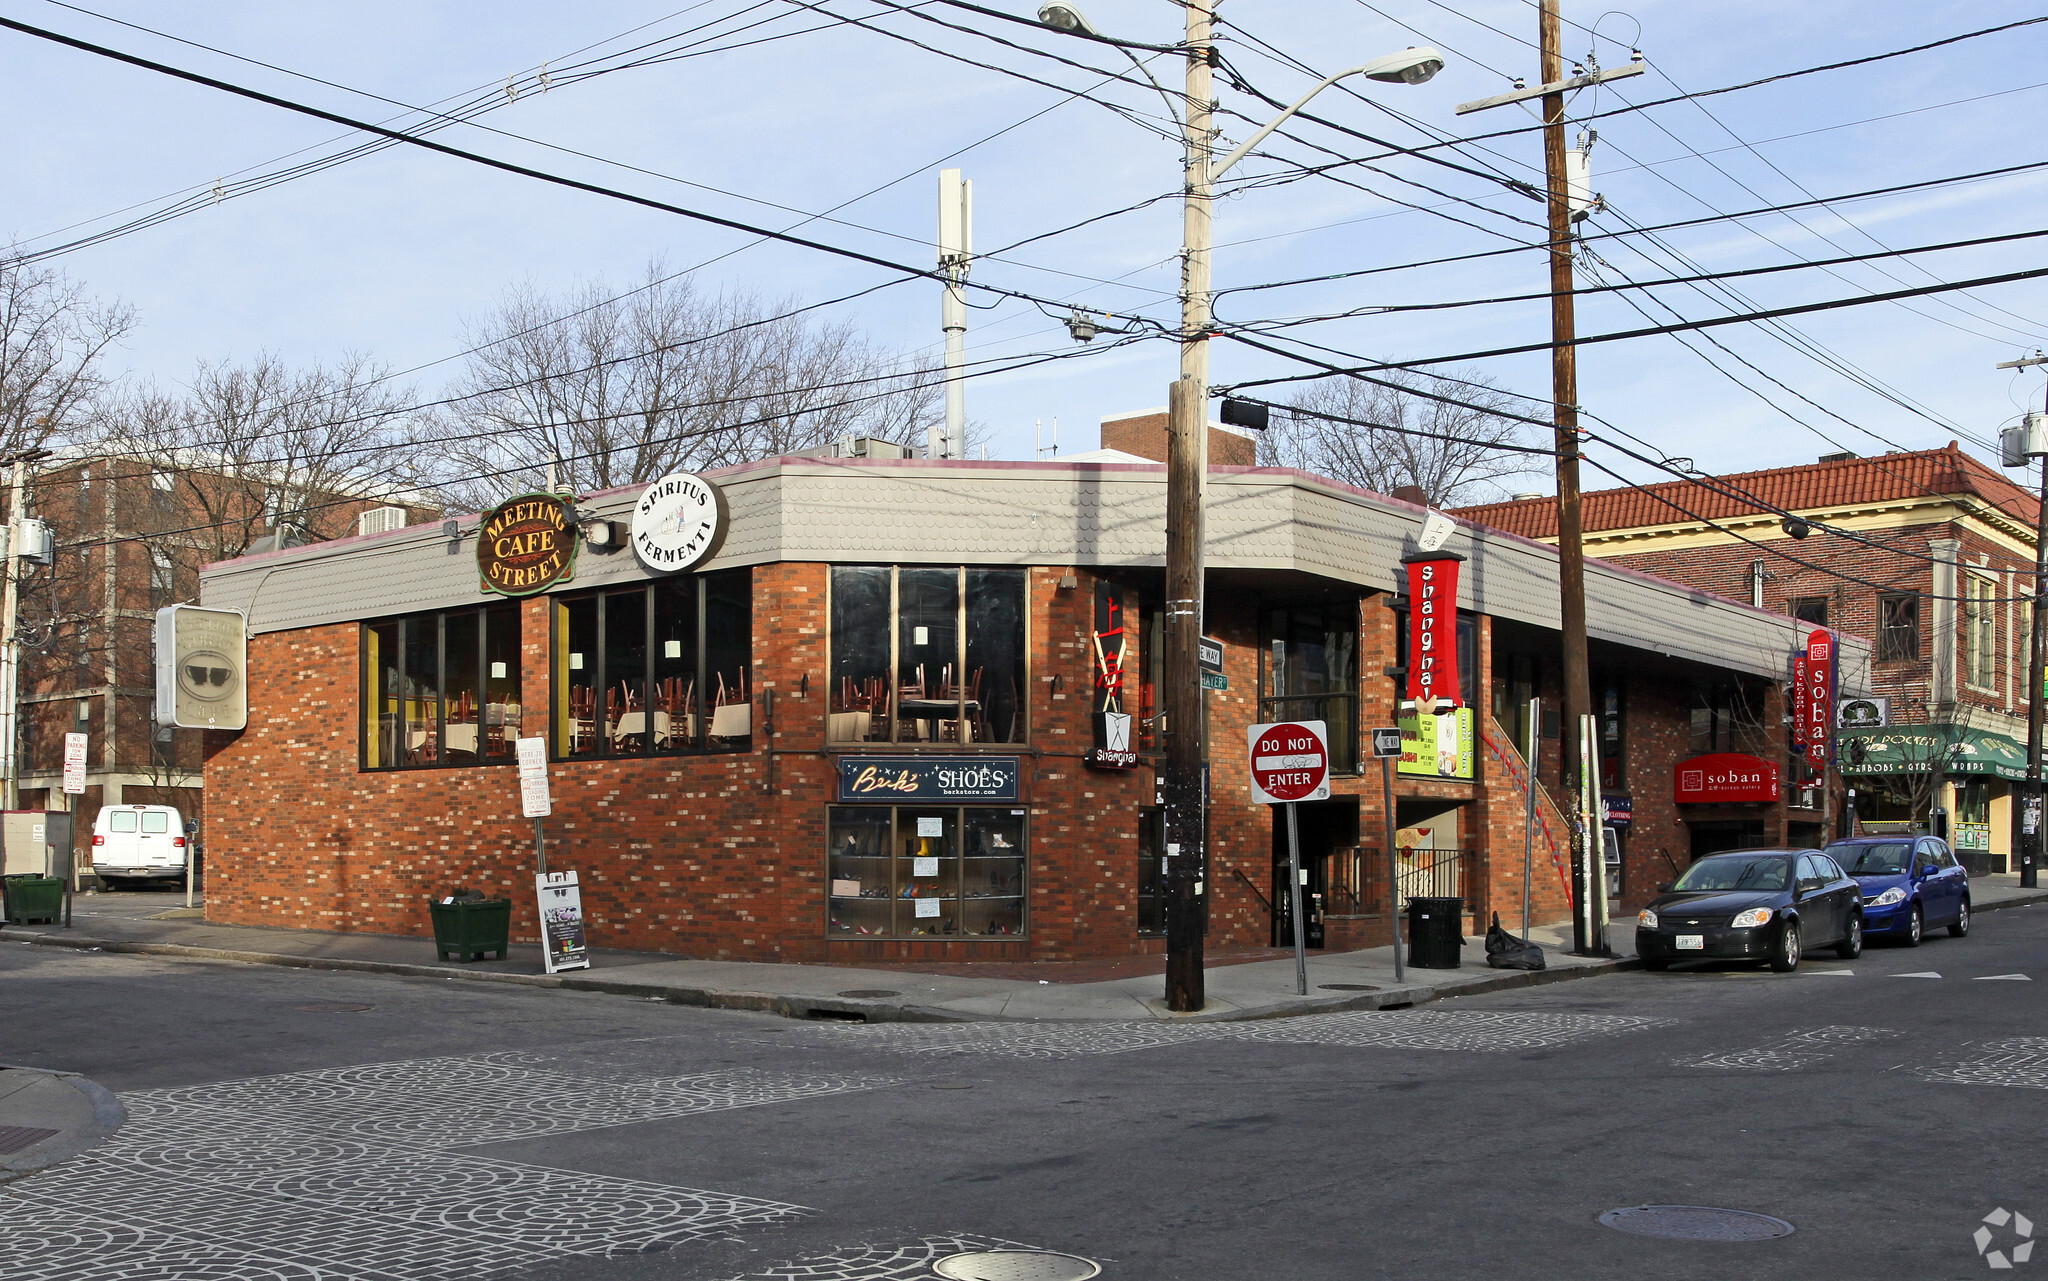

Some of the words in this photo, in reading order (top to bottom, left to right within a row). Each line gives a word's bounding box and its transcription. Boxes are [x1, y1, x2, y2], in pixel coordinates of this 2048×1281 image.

[641, 480, 708, 515] SPIRITUS
[486, 502, 565, 542] MEETING
[494, 529, 555, 559] CAFE
[638, 522, 711, 563] FERMENTI
[489, 550, 562, 586] STREET
[1206, 648, 1219, 663] WAY
[1202, 673, 1223, 689] HAYER
[1812, 670, 1826, 757] soban
[1796, 713, 1805, 742] eatey
[1262, 739, 1280, 752] DO
[1288, 737, 1313, 750] NOT
[1881, 735, 1938, 747] POCKETS
[1097, 749, 1136, 767] Shanghai
[1951, 762, 1984, 771] WRAPS
[852, 764, 919, 793] Berk's
[937, 770, 1004, 789] SHOES
[1268, 773, 1311, 787] ENTER
[1708, 770, 1761, 784] soban
